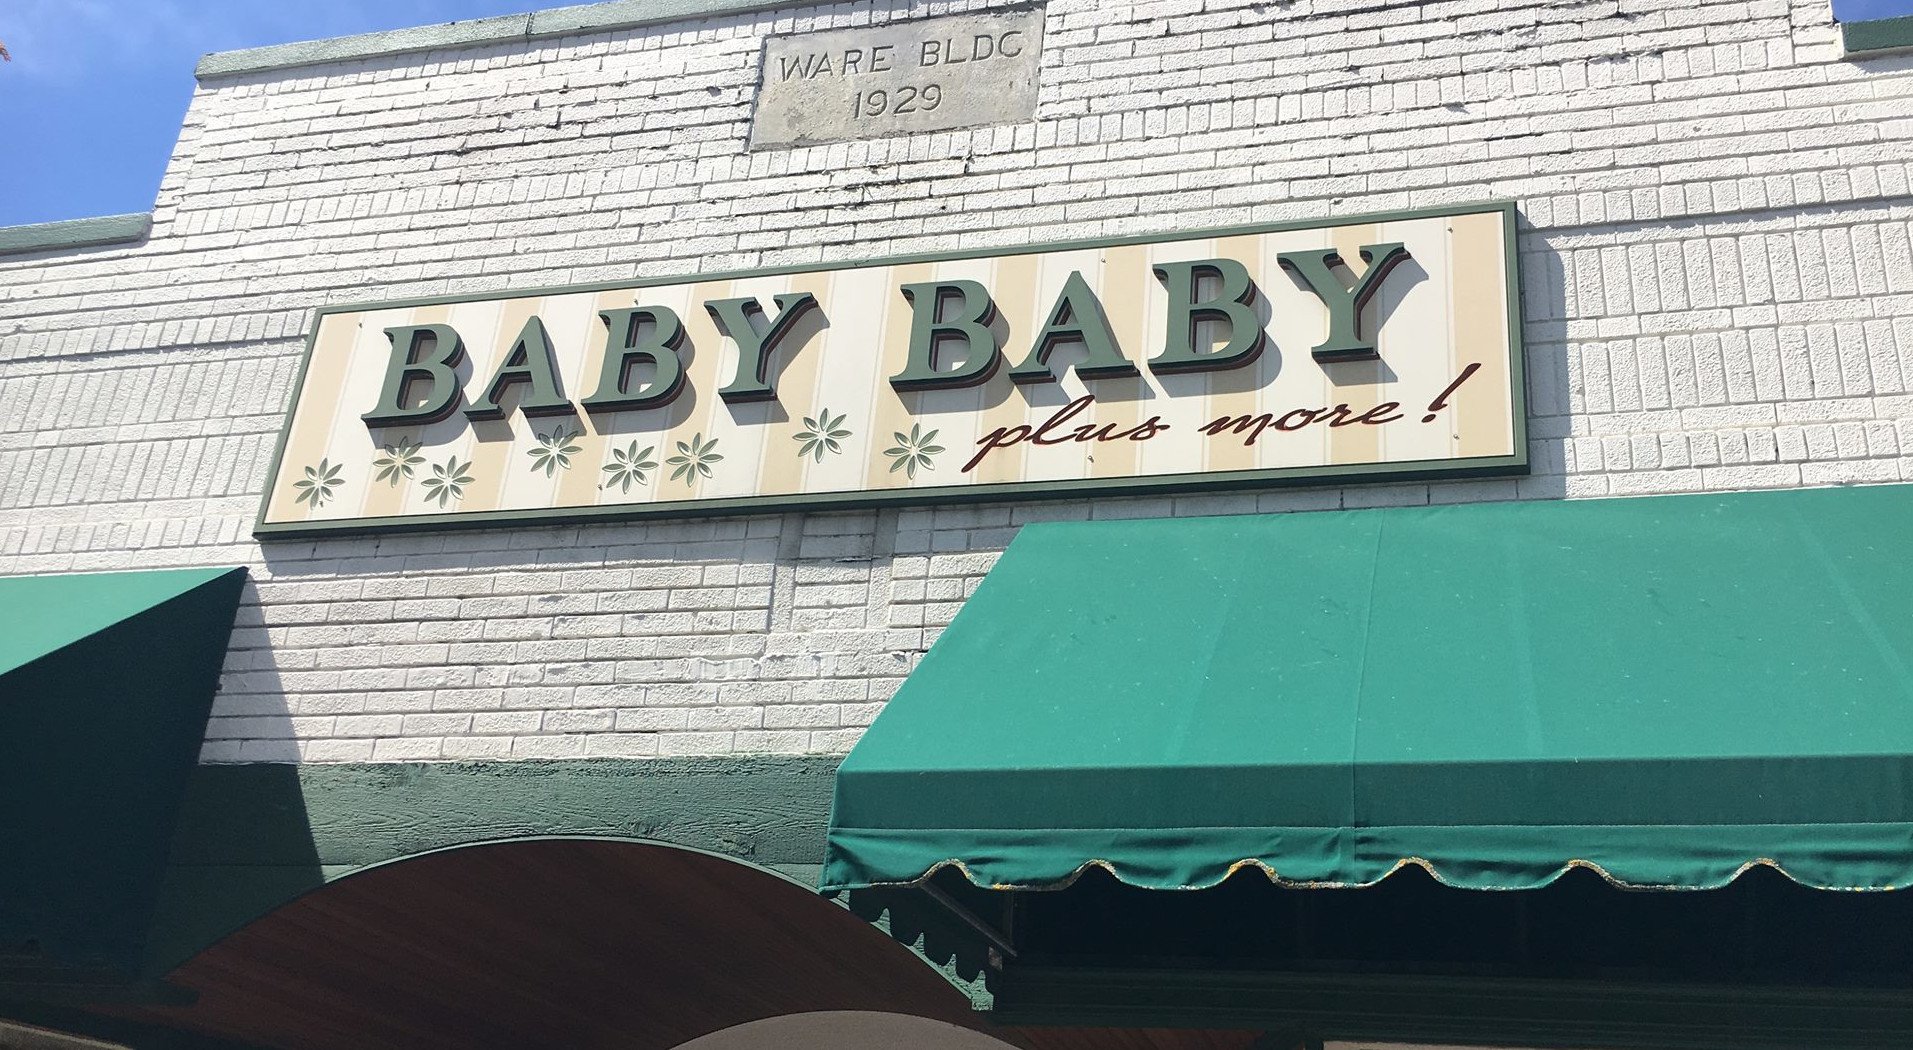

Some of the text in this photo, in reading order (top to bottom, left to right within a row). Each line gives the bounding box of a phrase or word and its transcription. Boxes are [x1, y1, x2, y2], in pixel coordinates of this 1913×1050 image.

[780, 45, 894, 82] WARE
[853, 84, 942, 119] 1929
[361, 242, 1412, 428] BABY BABY
[961, 394, 1170, 473] plus
